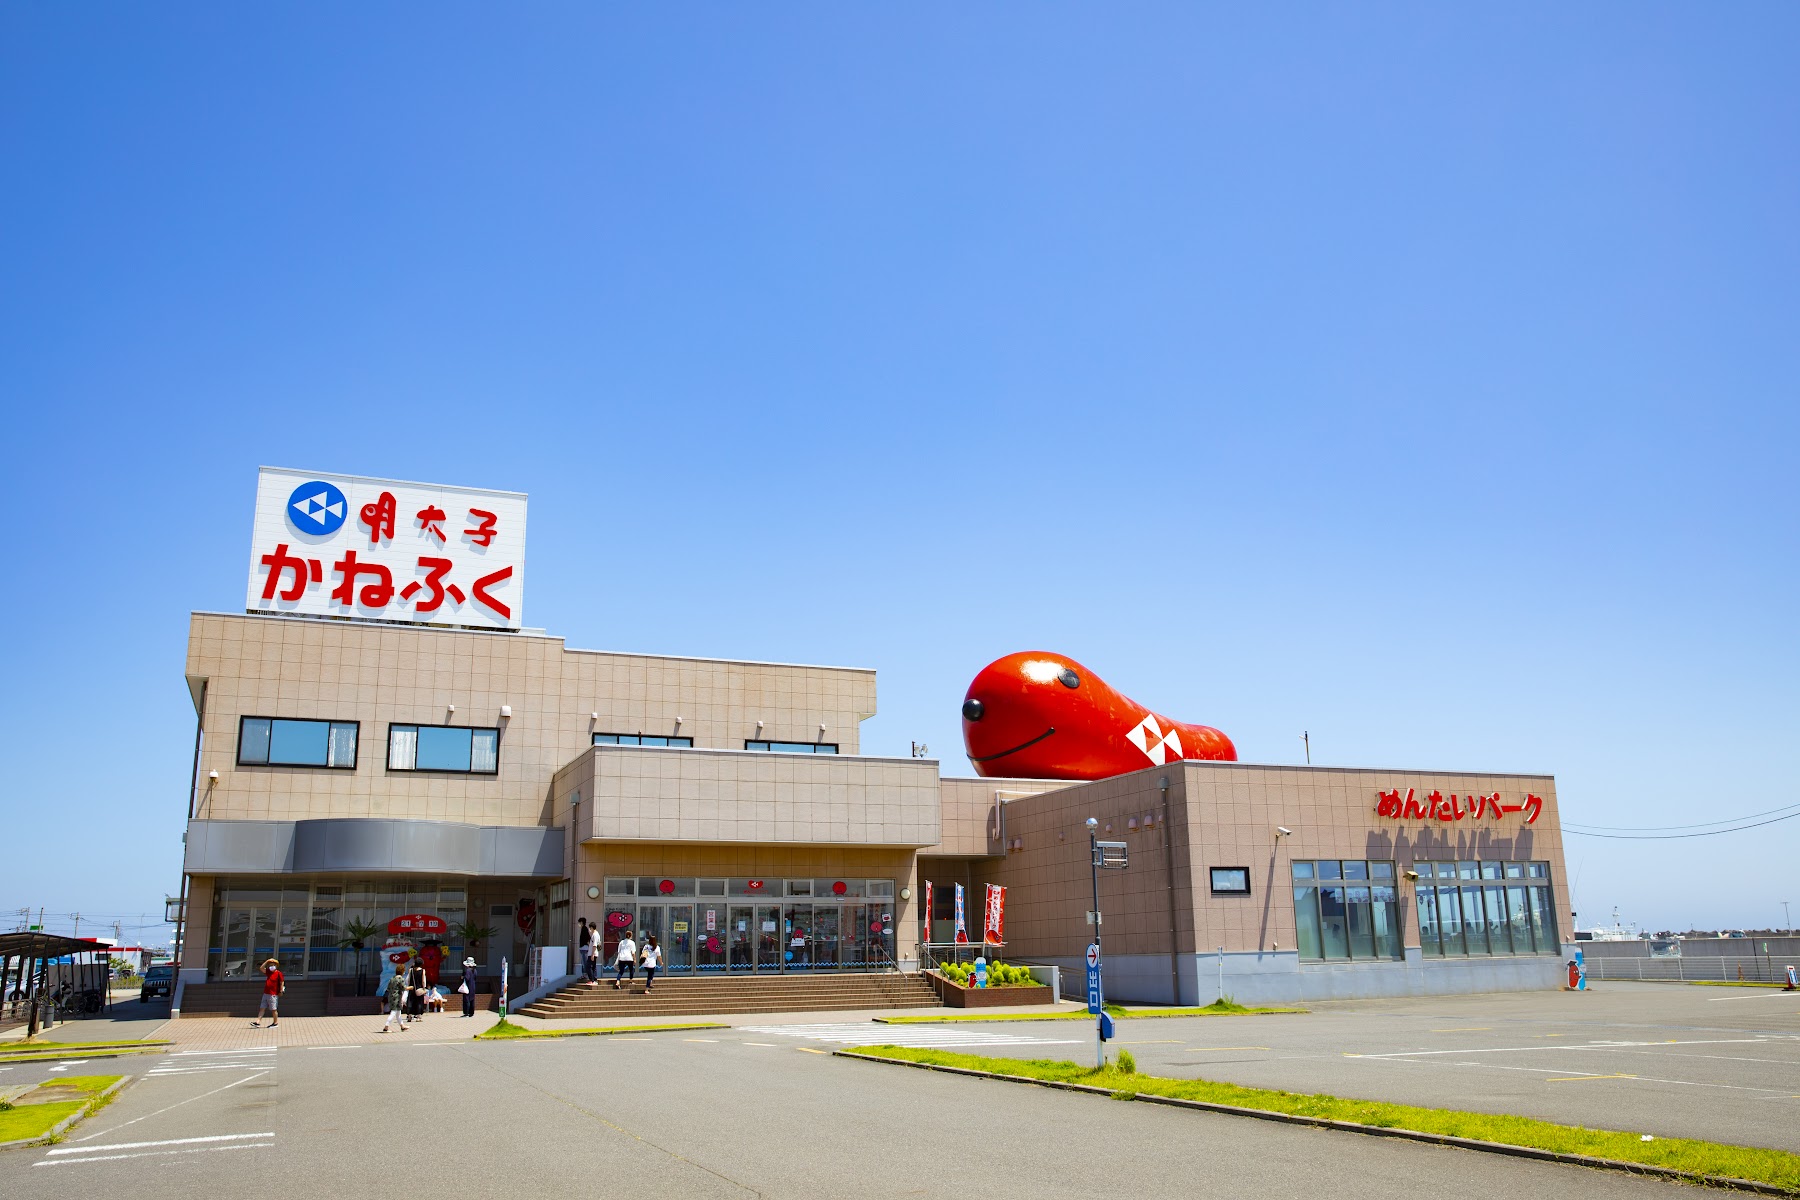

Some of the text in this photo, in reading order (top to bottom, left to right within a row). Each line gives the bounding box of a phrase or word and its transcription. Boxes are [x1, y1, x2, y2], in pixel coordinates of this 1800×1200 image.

[360, 491, 498, 547] 明太子
[261, 544, 513, 620] かねふく
[1376, 788, 1543, 824] めんたいパーク
[1089, 970, 1099, 1008] 出口
